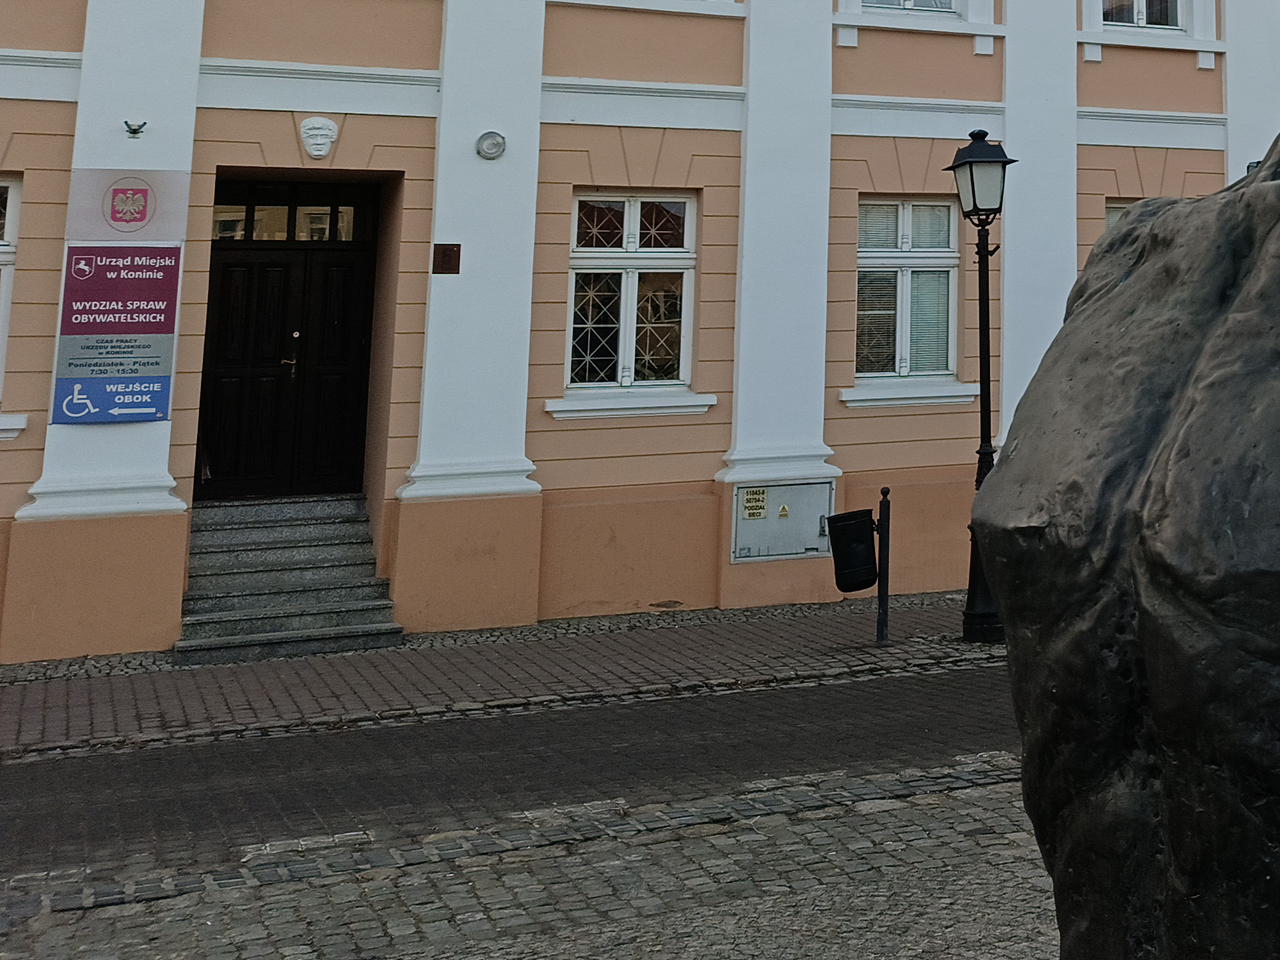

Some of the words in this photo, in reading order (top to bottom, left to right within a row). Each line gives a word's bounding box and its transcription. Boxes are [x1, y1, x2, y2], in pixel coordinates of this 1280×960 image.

[97, 256, 131, 267] Urząd
[134, 256, 175, 267] Miejski
[120, 269, 164, 279] Koninie
[72, 301, 124, 310] WYDZIAŁ
[126, 301, 167, 310] SPRAW
[71, 313, 165, 323] OBYWATELSKICH
[132, 360, 160, 368] Piątek
[105, 382, 162, 392] WEJŚCIE
[114, 394, 151, 403] OBOK
